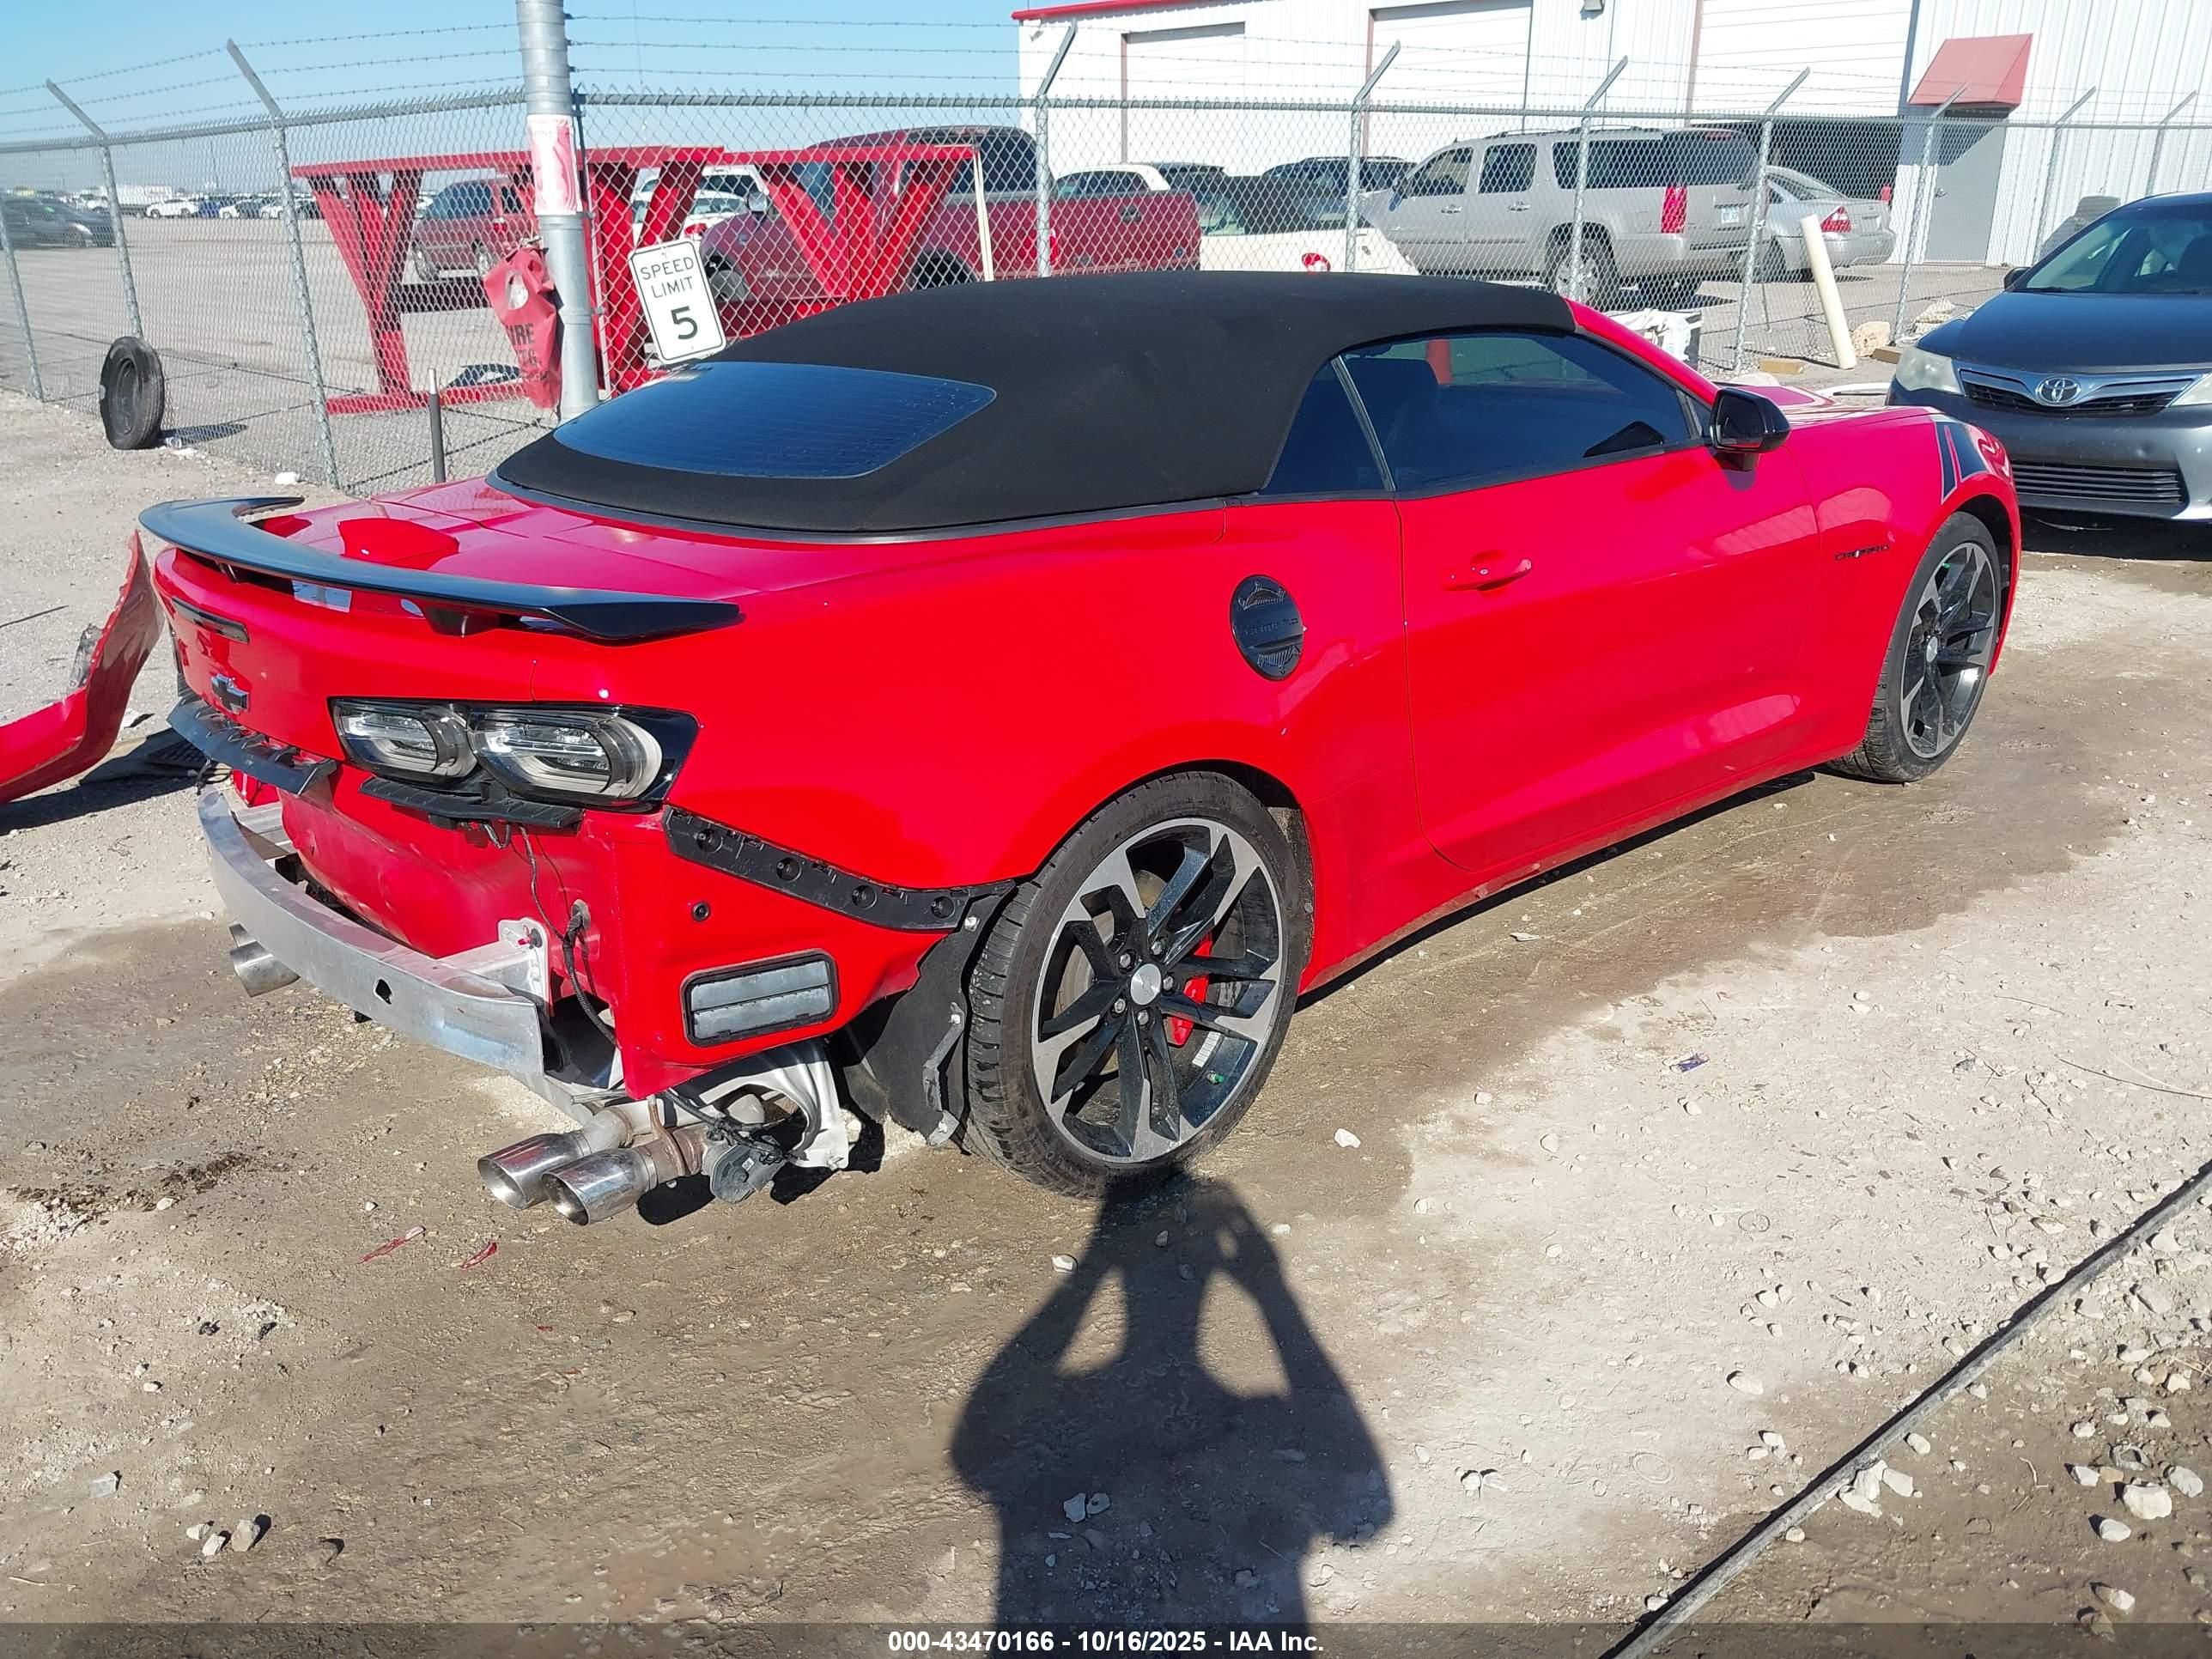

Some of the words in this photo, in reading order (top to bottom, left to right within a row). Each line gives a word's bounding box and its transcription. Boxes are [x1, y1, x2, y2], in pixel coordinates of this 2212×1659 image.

[640, 257, 695, 281] SPEED
[650, 276, 694, 299] LIMIT
[671, 306, 698, 340] 5
